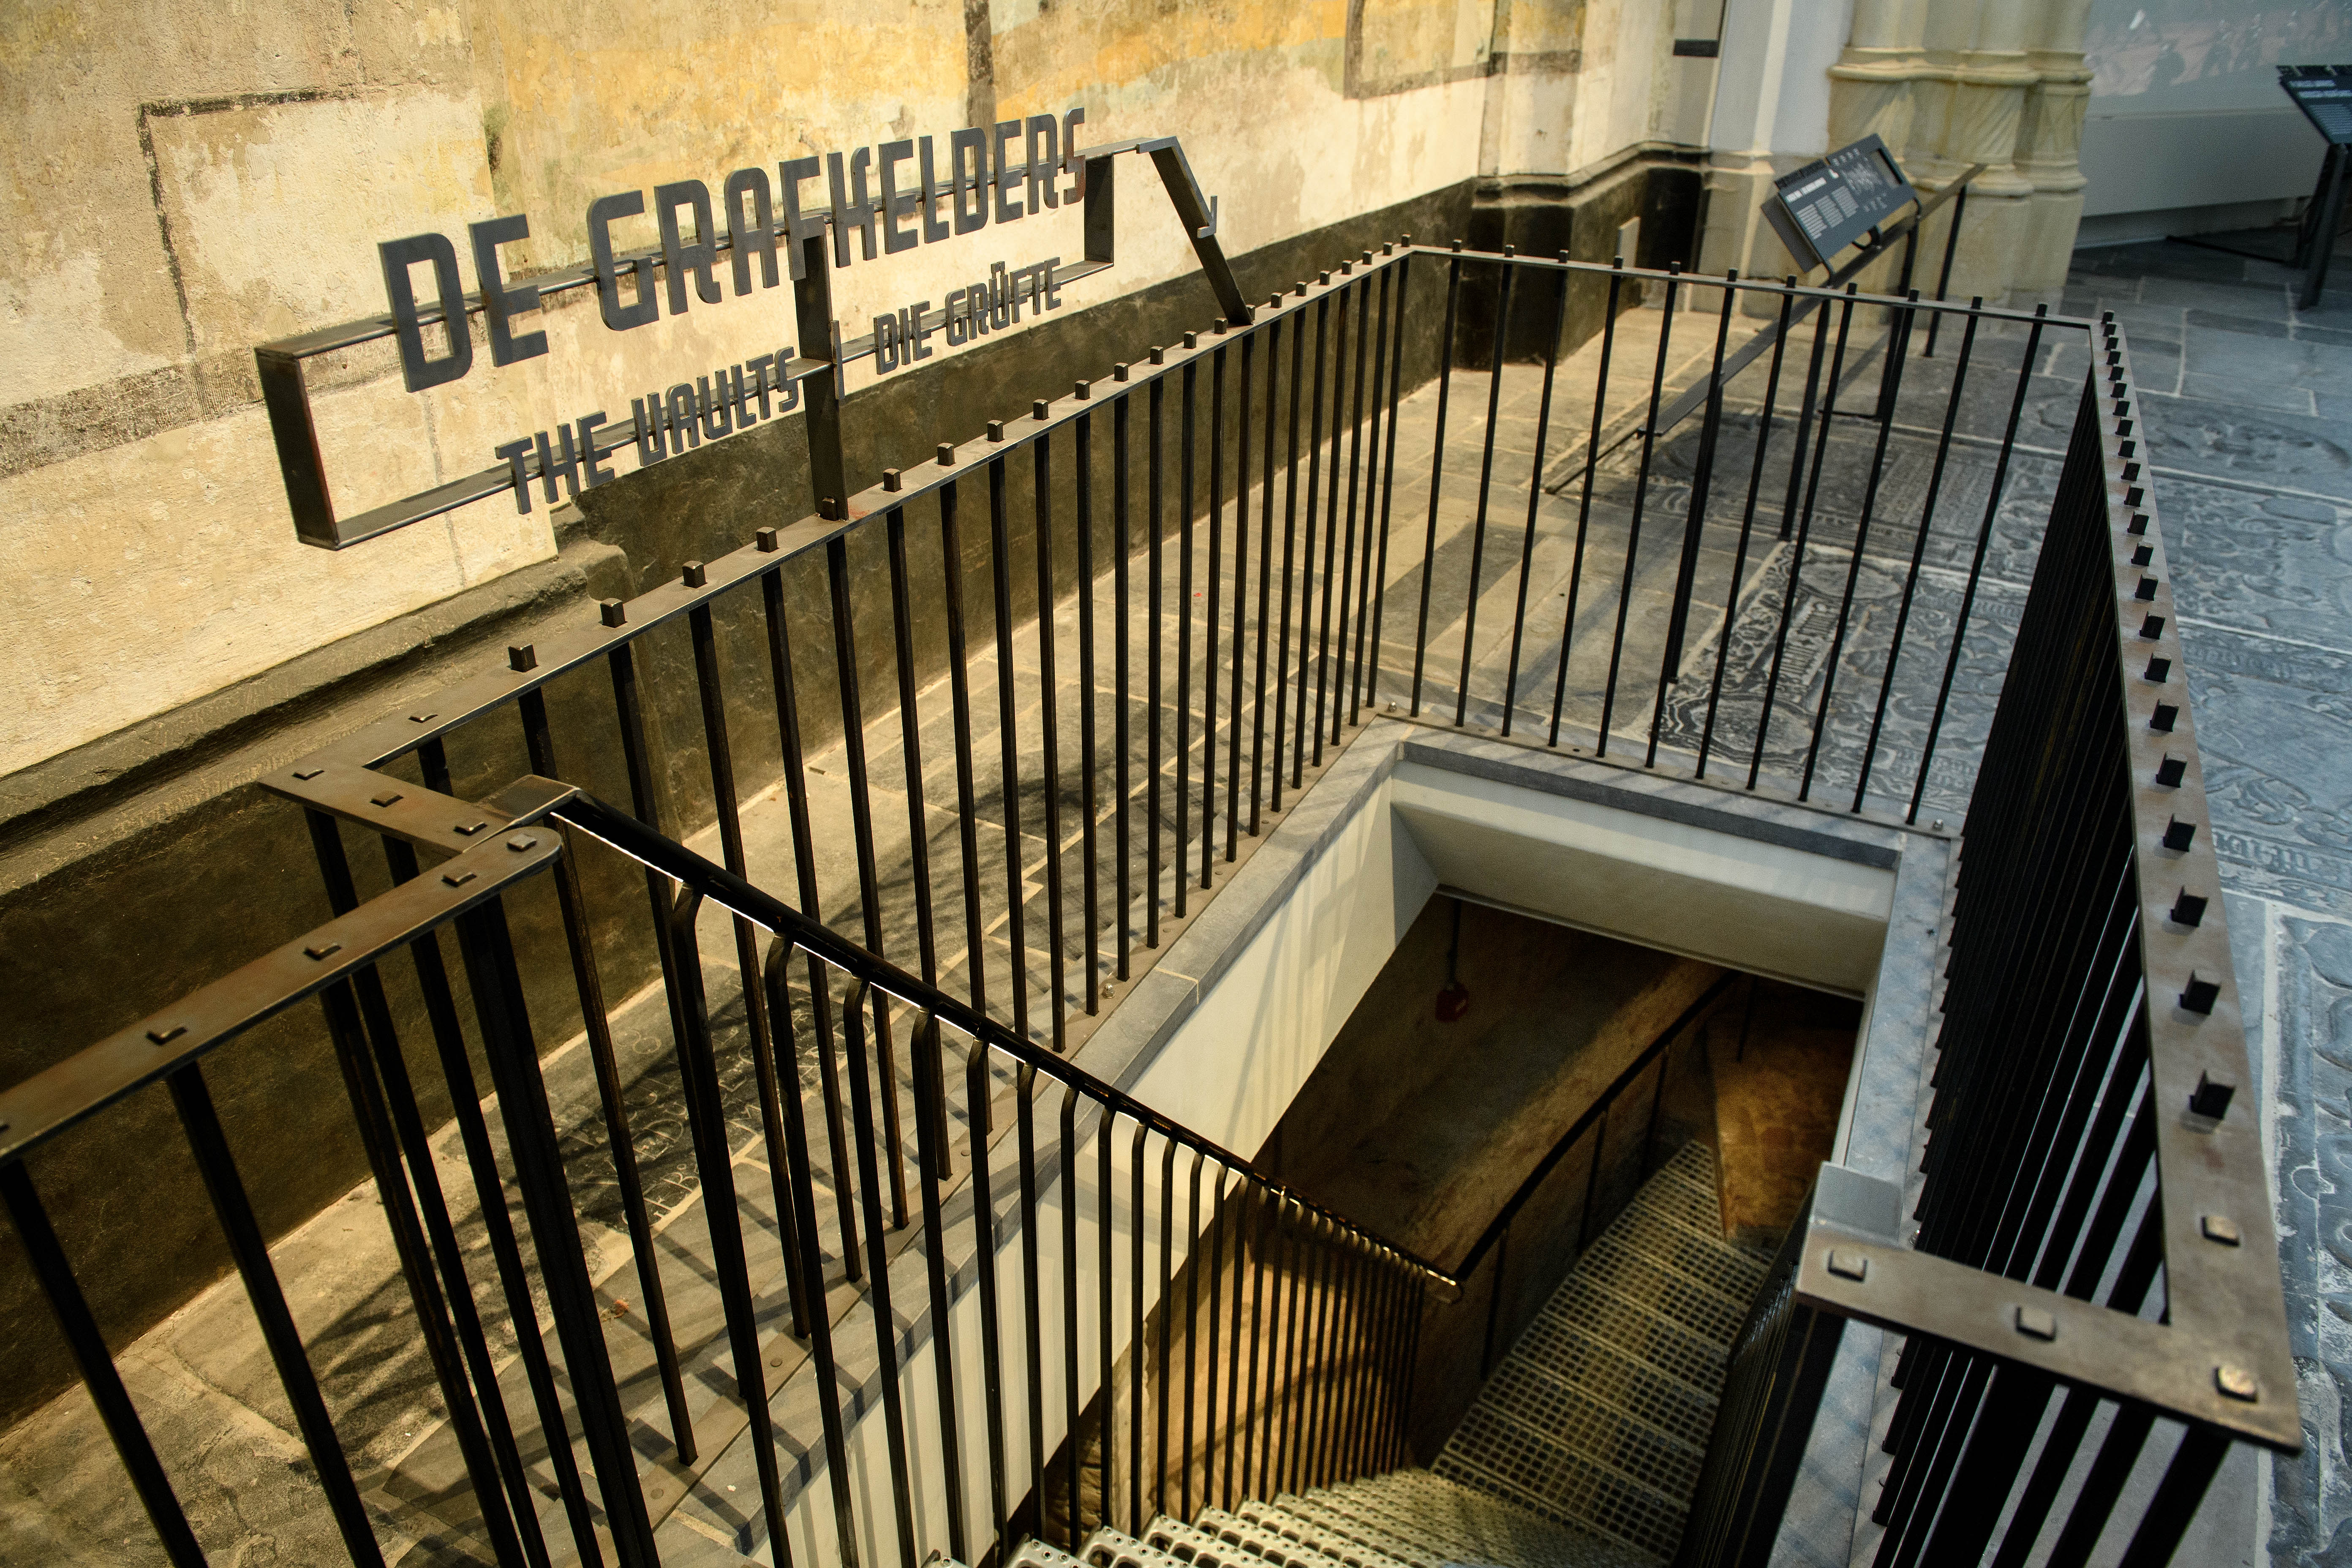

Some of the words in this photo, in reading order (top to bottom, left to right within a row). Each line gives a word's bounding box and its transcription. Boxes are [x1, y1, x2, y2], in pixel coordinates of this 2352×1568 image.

[377, 213, 549, 393] DE
[586, 107, 1086, 331] GRAFKELDERS
[874, 300, 932, 375] DIE
[945, 256, 1061, 346] GRÜFTE
[495, 410, 615, 514] THE
[631, 346, 799, 466] VAULTS
